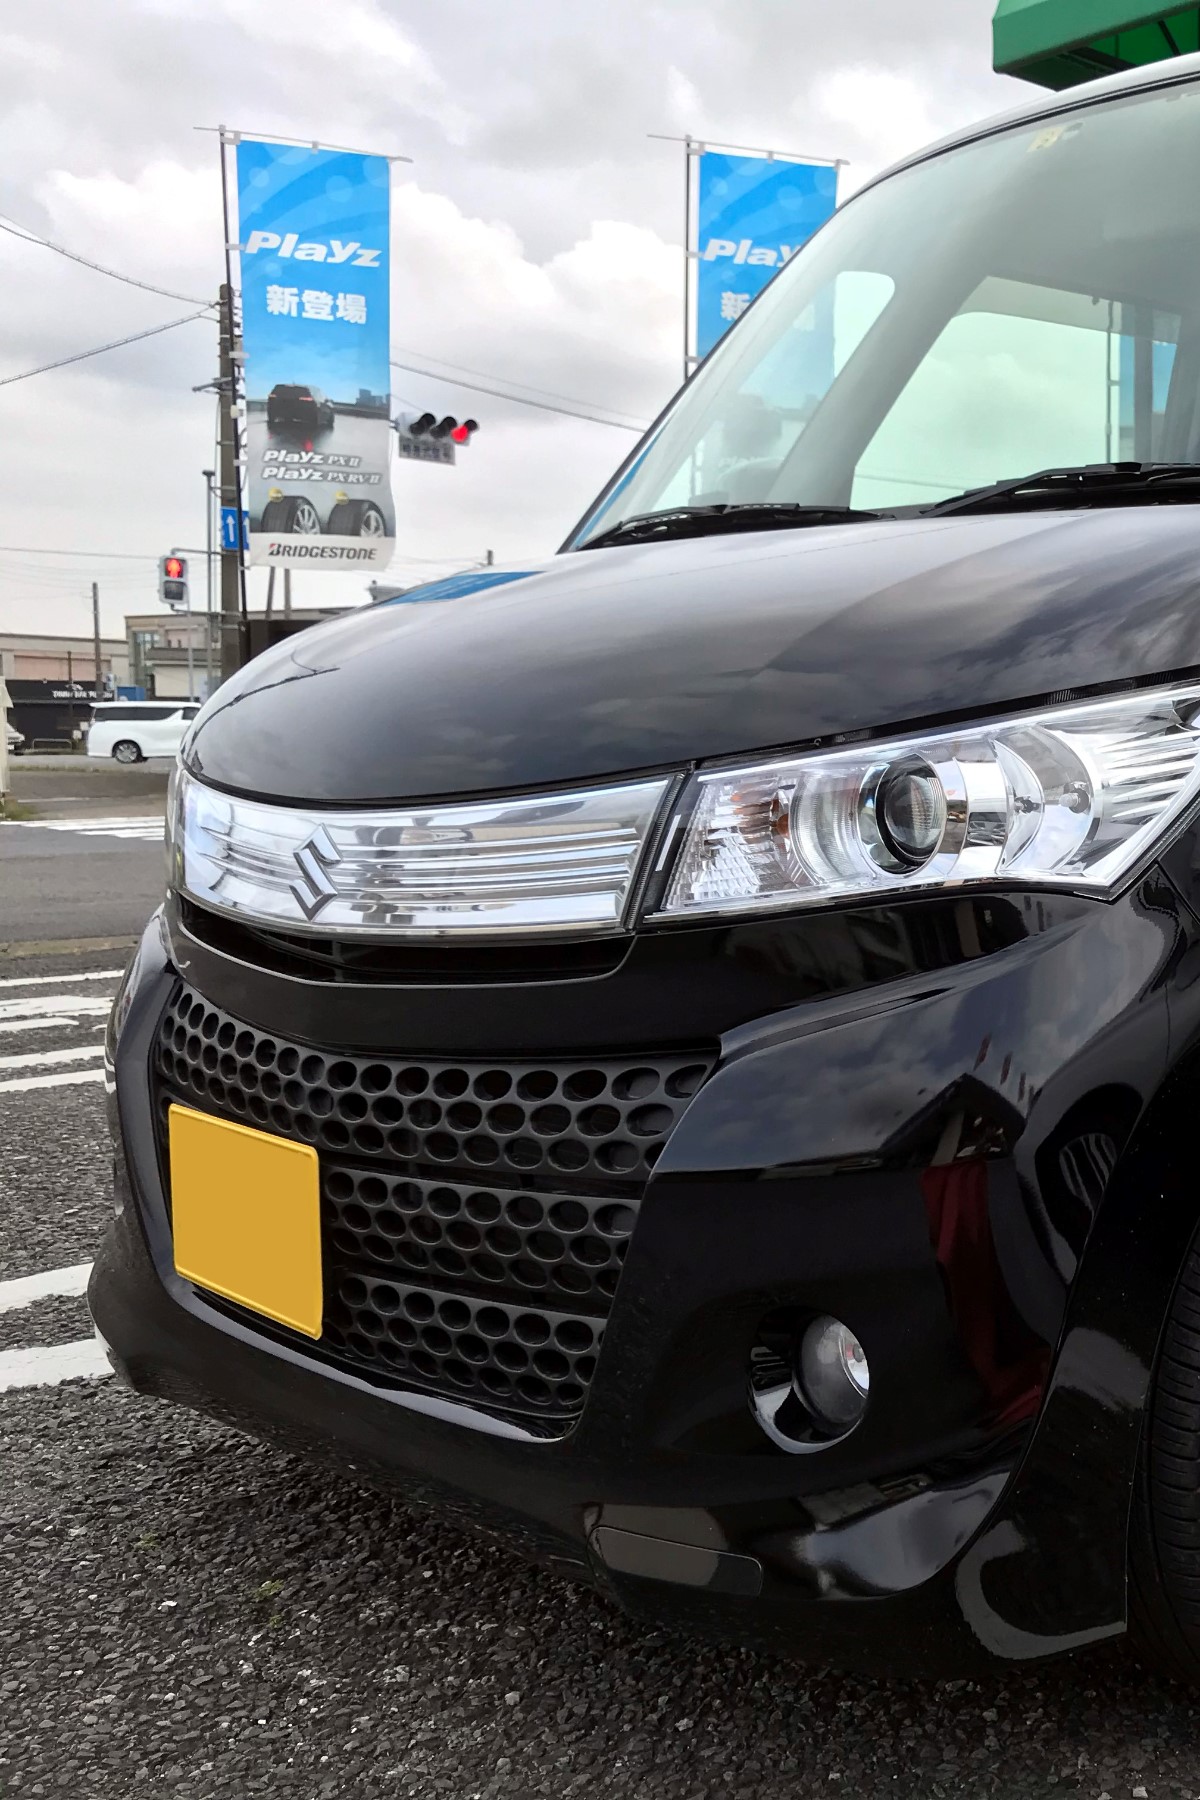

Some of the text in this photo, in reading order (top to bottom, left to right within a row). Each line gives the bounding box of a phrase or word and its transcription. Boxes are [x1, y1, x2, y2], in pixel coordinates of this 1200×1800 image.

[245, 230, 382, 268] Playz
[266, 284, 367, 325] 新登場
[263, 450, 324, 464] Playz
[262, 466, 323, 480] Playz
[268, 543, 377, 560] BRIDGESTONE
